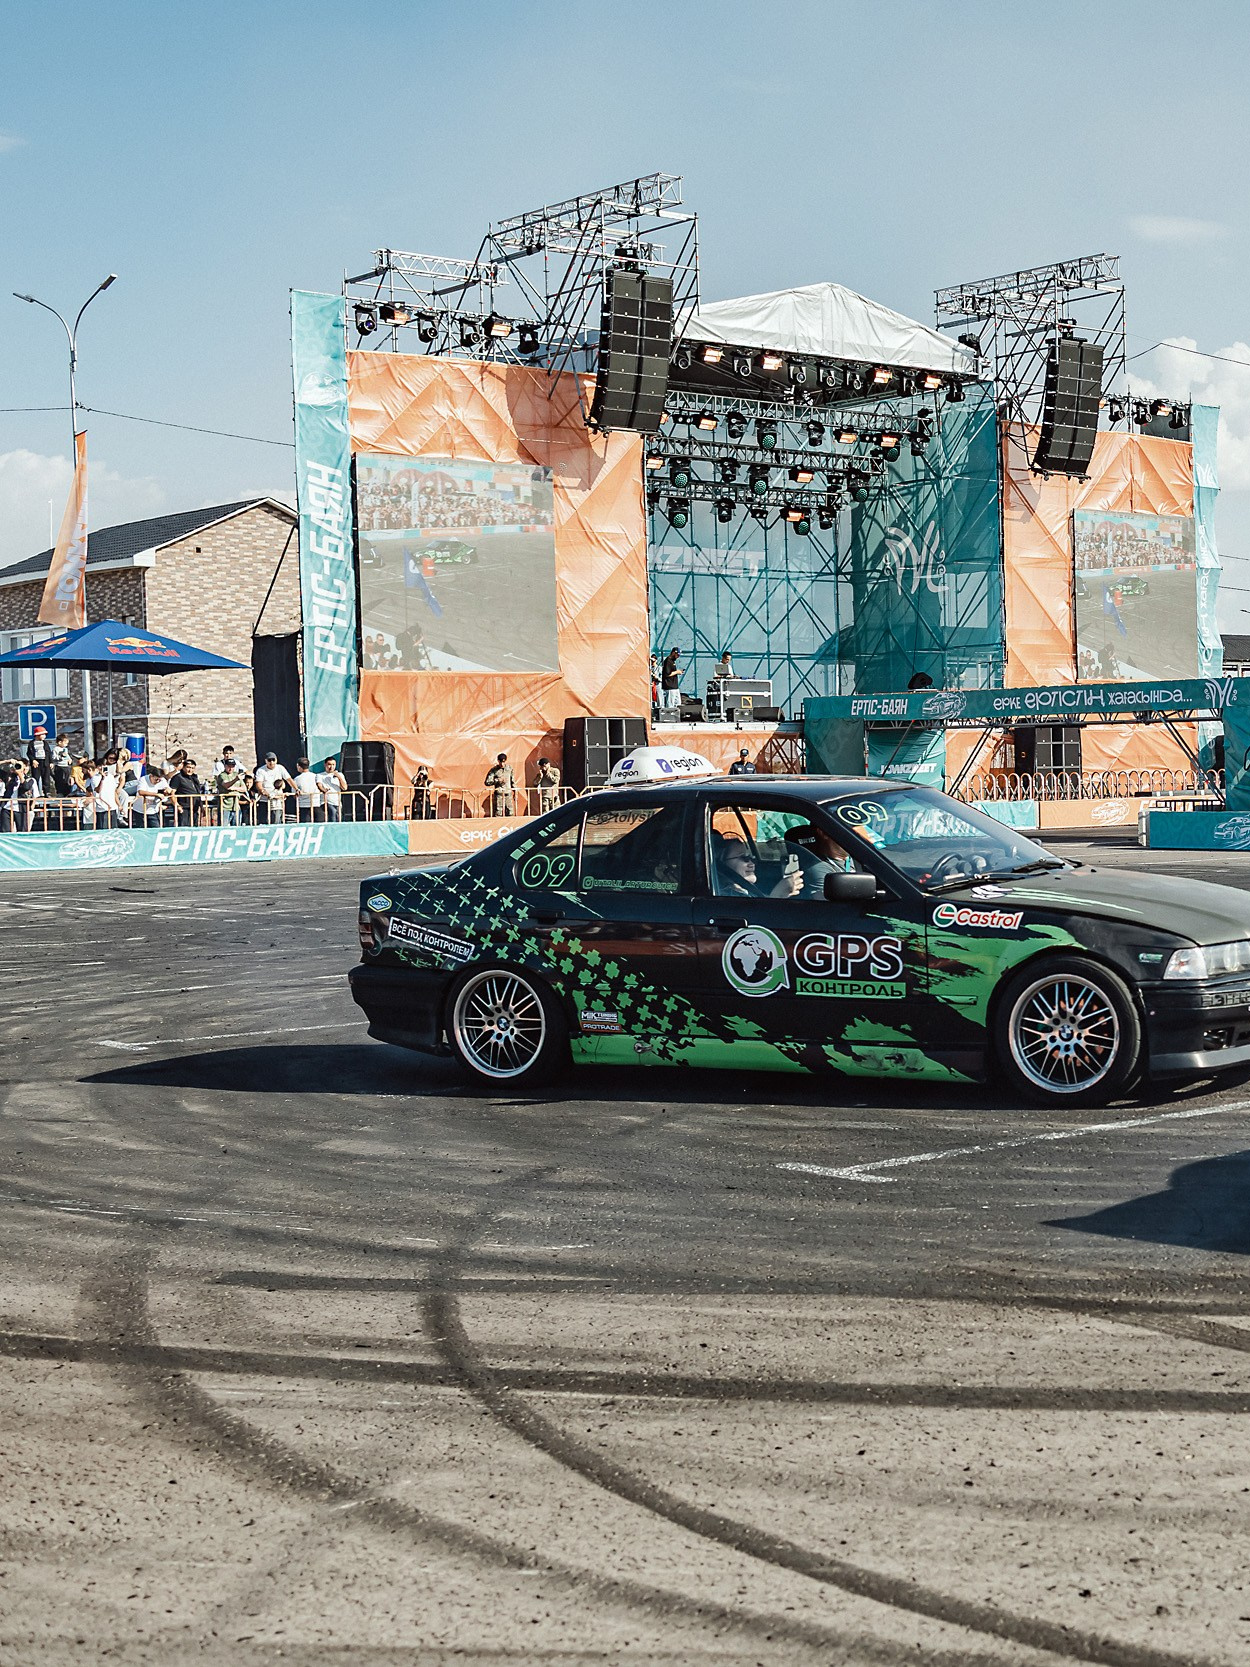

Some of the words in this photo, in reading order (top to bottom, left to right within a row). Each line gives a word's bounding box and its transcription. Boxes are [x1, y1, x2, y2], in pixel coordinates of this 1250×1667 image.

[307, 459, 348, 675] ЕРТІС-БАЯН
[106, 646, 146, 655] Red
[147, 648, 181, 658] Bull
[851, 698, 908, 717] ЕРТІС-БАЯН
[27, 709, 48, 736] P
[614, 769, 639, 780] region
[670, 756, 704, 771] region
[837, 800, 889, 826] 09
[151, 825, 325, 862] ЕРТІС-БАЯН
[521, 853, 576, 888] 09
[955, 909, 1023, 929] Castrol
[391, 922, 407, 936] ВСЁ
[407, 928, 423, 943] ПОД
[423, 934, 471, 957] КОНТРОЛЕМ
[793, 932, 904, 980] GPS
[800, 980, 904, 998] КОНТРОЛЬ
